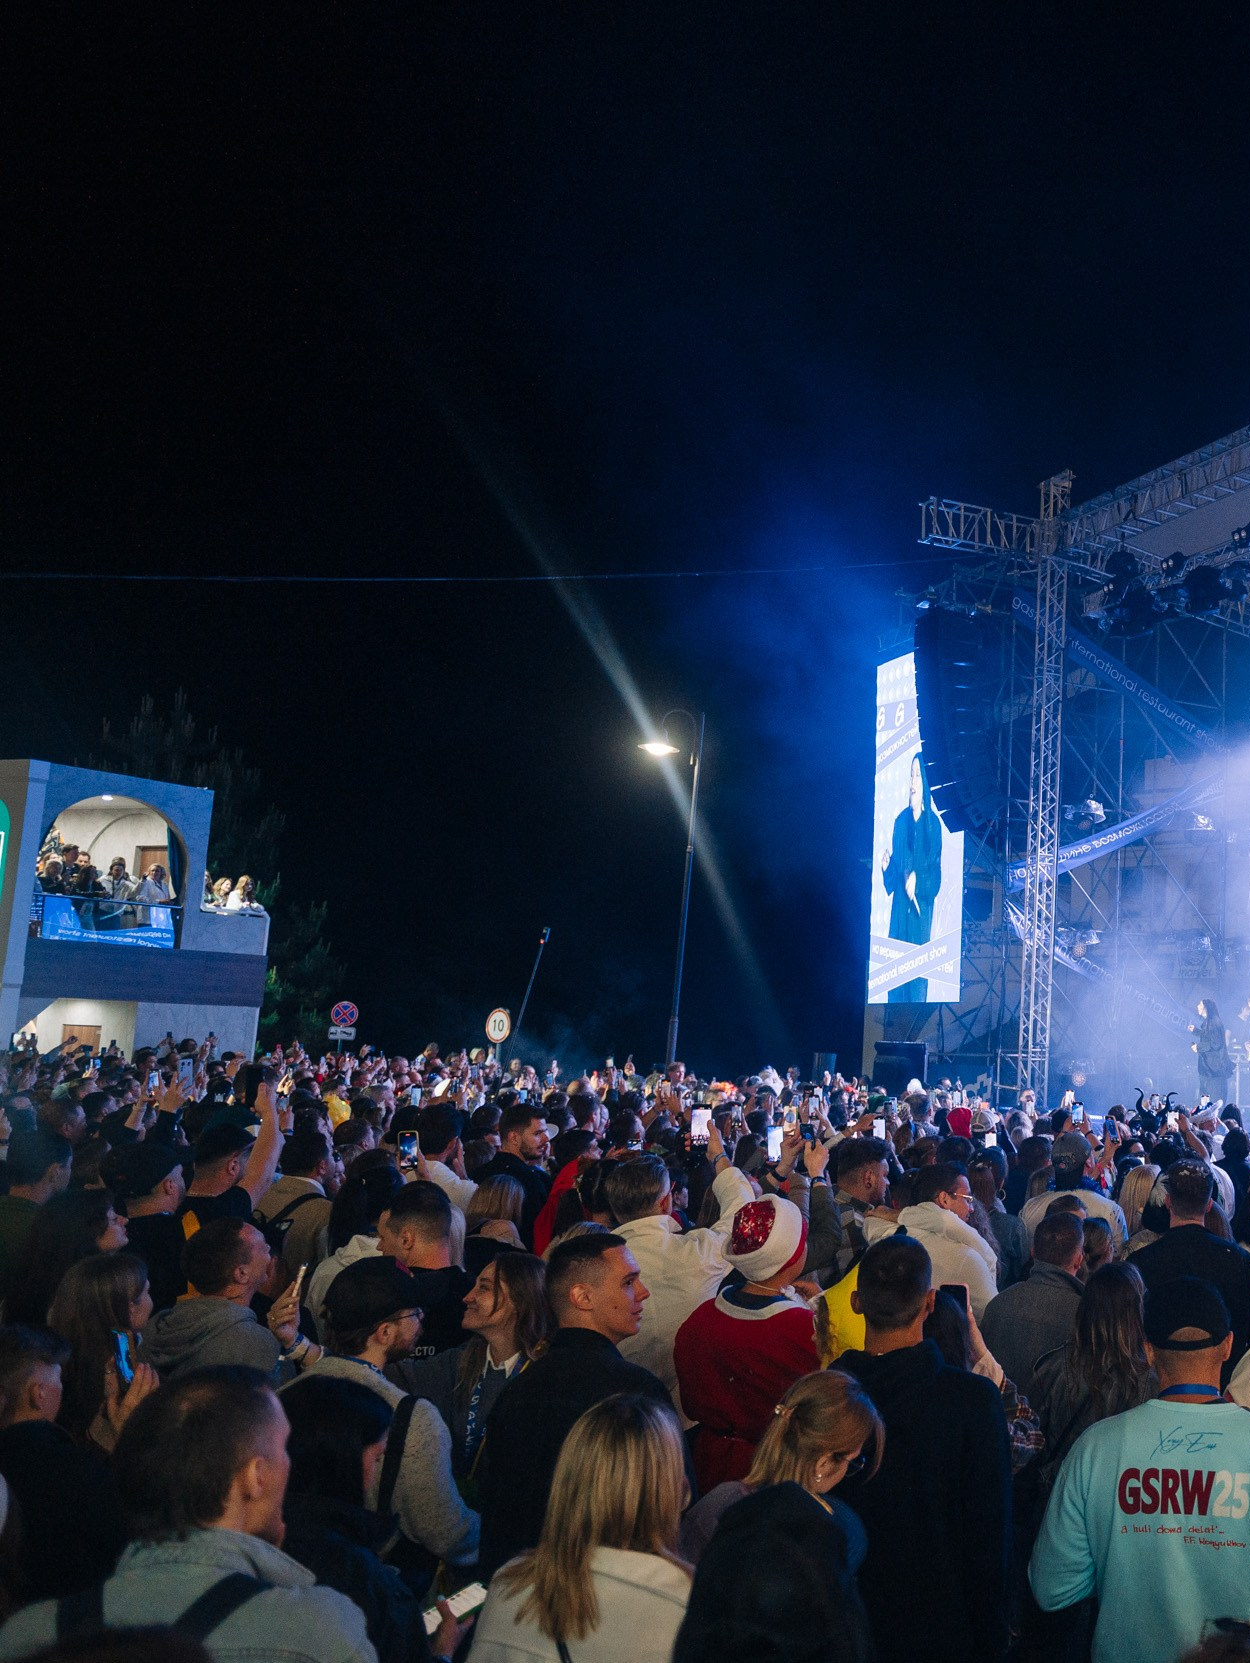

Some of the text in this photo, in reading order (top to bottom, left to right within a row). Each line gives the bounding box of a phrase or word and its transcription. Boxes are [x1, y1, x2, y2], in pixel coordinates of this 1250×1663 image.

[1064, 633, 1138, 692] ternational
[1138, 688, 1197, 733] restaurant
[493, 1018, 504, 1032] 10
